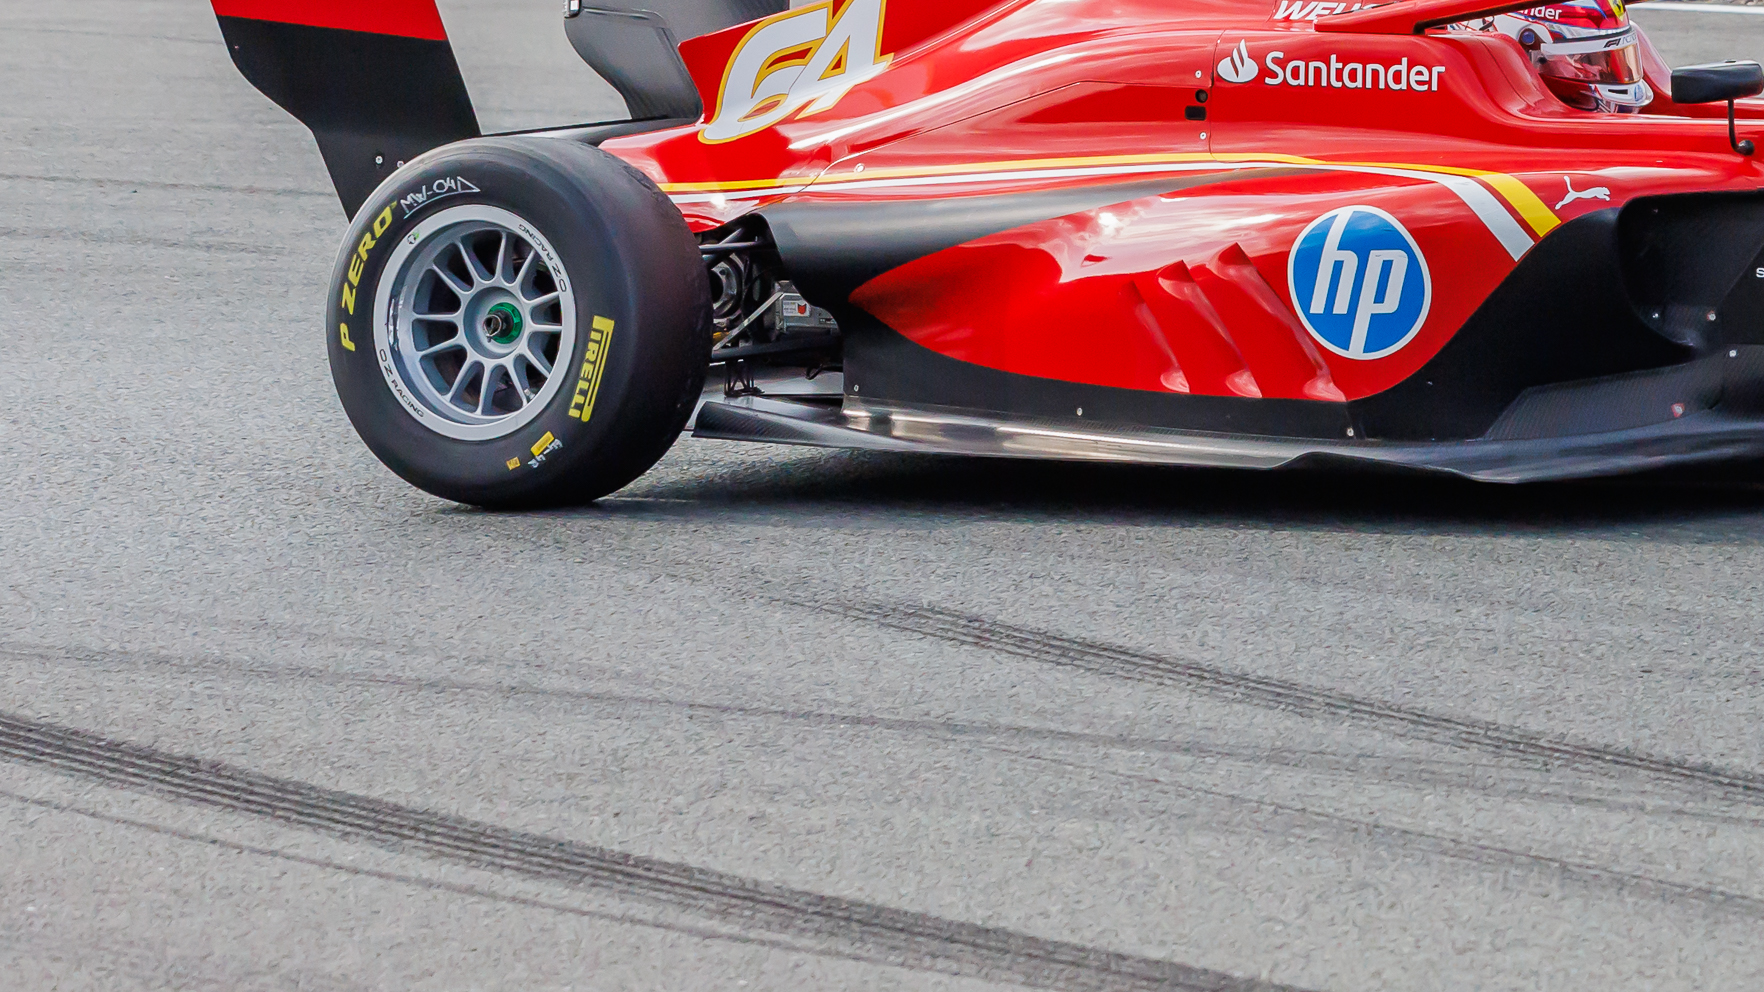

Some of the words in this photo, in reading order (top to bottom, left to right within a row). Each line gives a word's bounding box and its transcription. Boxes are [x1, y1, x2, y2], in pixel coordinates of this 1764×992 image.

[1264, 50, 1446, 93] Santander
[341, 205, 394, 316] ZERO
[517, 222, 554, 262] RACING
[1309, 207, 1410, 359] hp
[391, 379, 425, 418] RACING
[568, 314, 615, 422] PIRELLI
